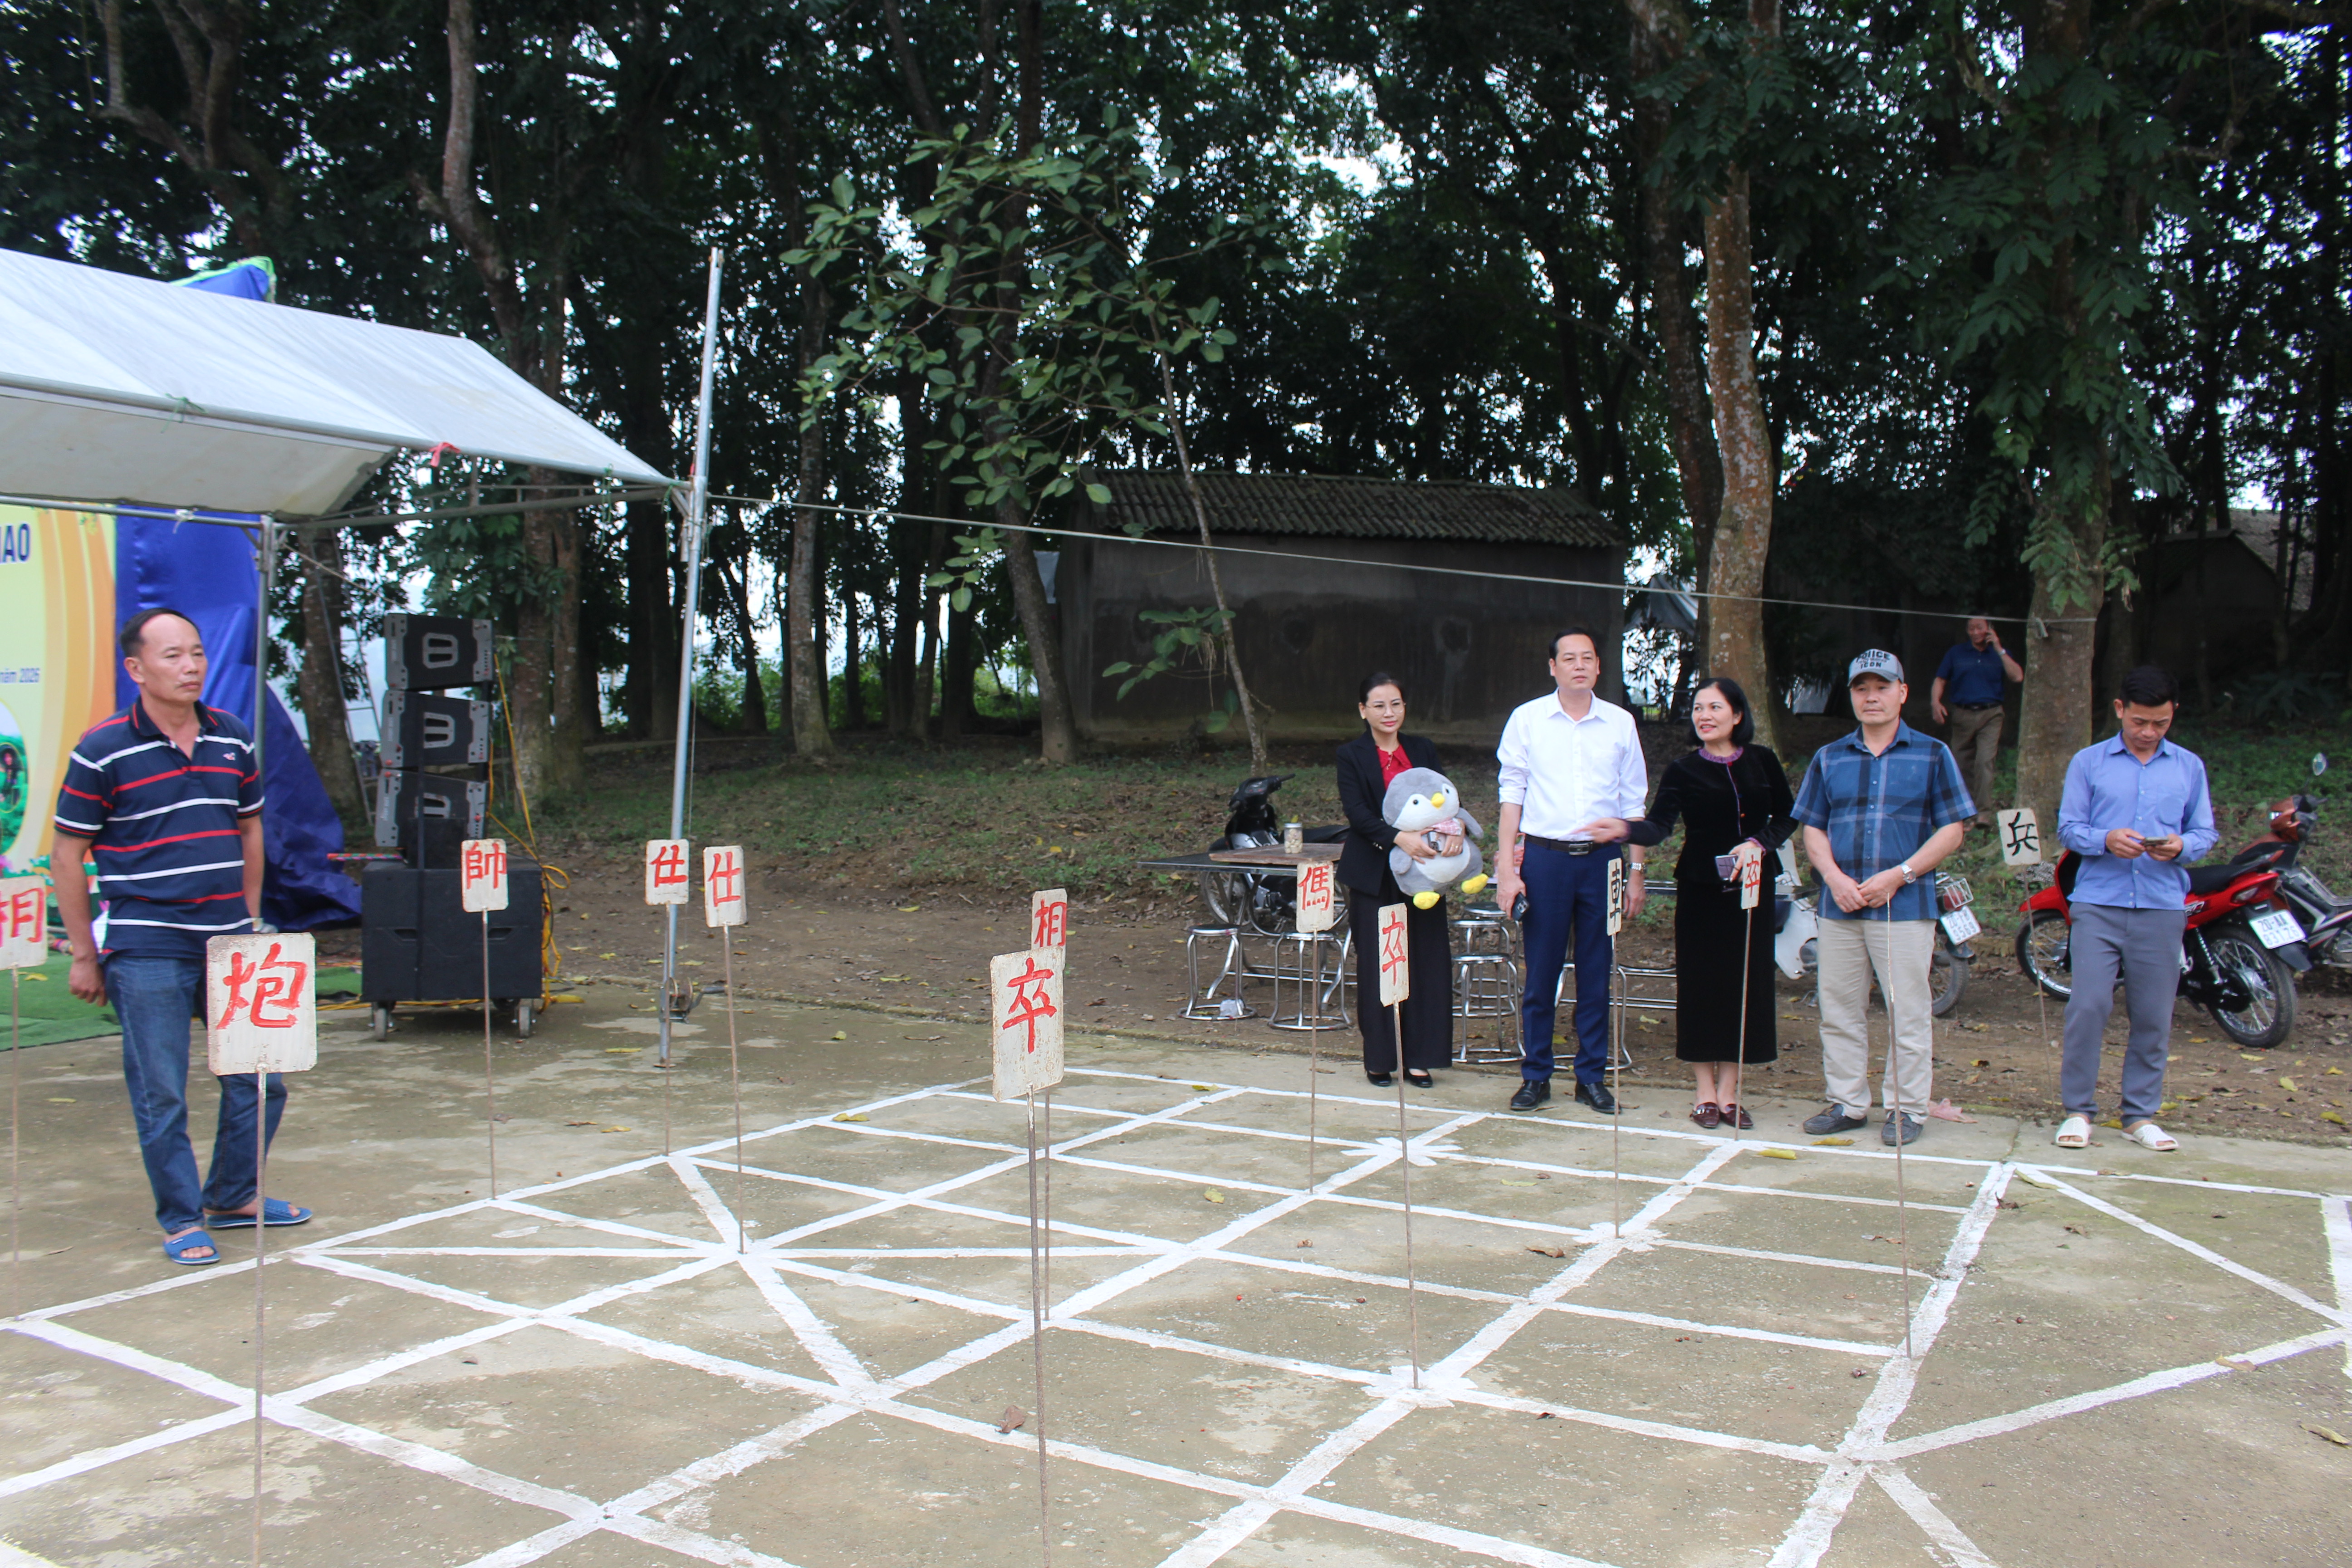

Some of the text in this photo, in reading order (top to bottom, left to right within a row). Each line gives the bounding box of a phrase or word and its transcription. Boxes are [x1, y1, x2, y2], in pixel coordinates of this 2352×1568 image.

[0, 524, 30, 562] AO
[2009, 812, 2038, 856] 兵
[466, 841, 507, 889] 帥
[708, 852, 741, 907] 仕
[1034, 899, 1066, 947] 相
[216, 942, 309, 1029] 炮
[1002, 957, 1057, 1054] 卒
